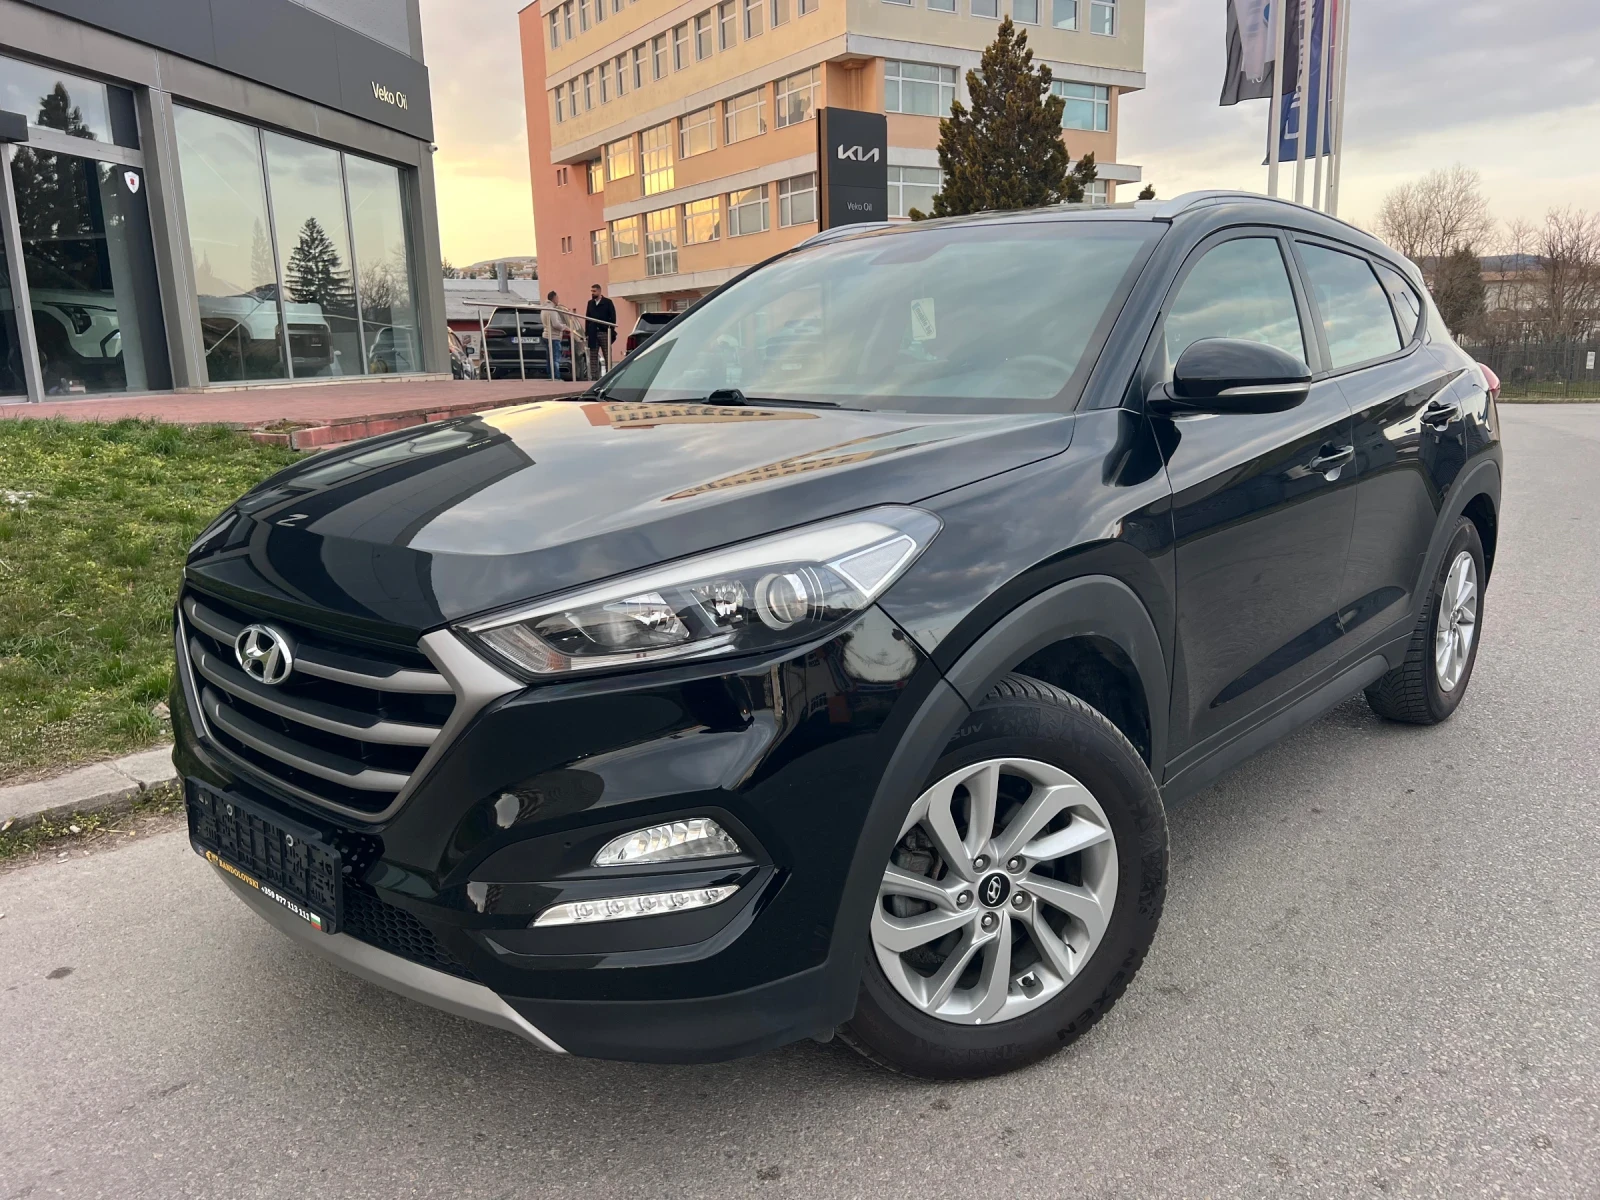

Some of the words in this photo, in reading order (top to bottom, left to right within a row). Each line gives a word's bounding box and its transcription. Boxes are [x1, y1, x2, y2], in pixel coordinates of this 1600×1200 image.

[372, 81, 394, 104] Veko
[396, 92, 408, 110] Oil
[838, 144, 880, 162] KIA
[847, 202, 862, 211] Veko
[864, 202, 872, 212] Oil
[276, 894, 286, 905] 877
[287, 901, 298, 913] 113
[299, 908, 310, 921] 111
[1056, 947, 1136, 1040] NEXEN
